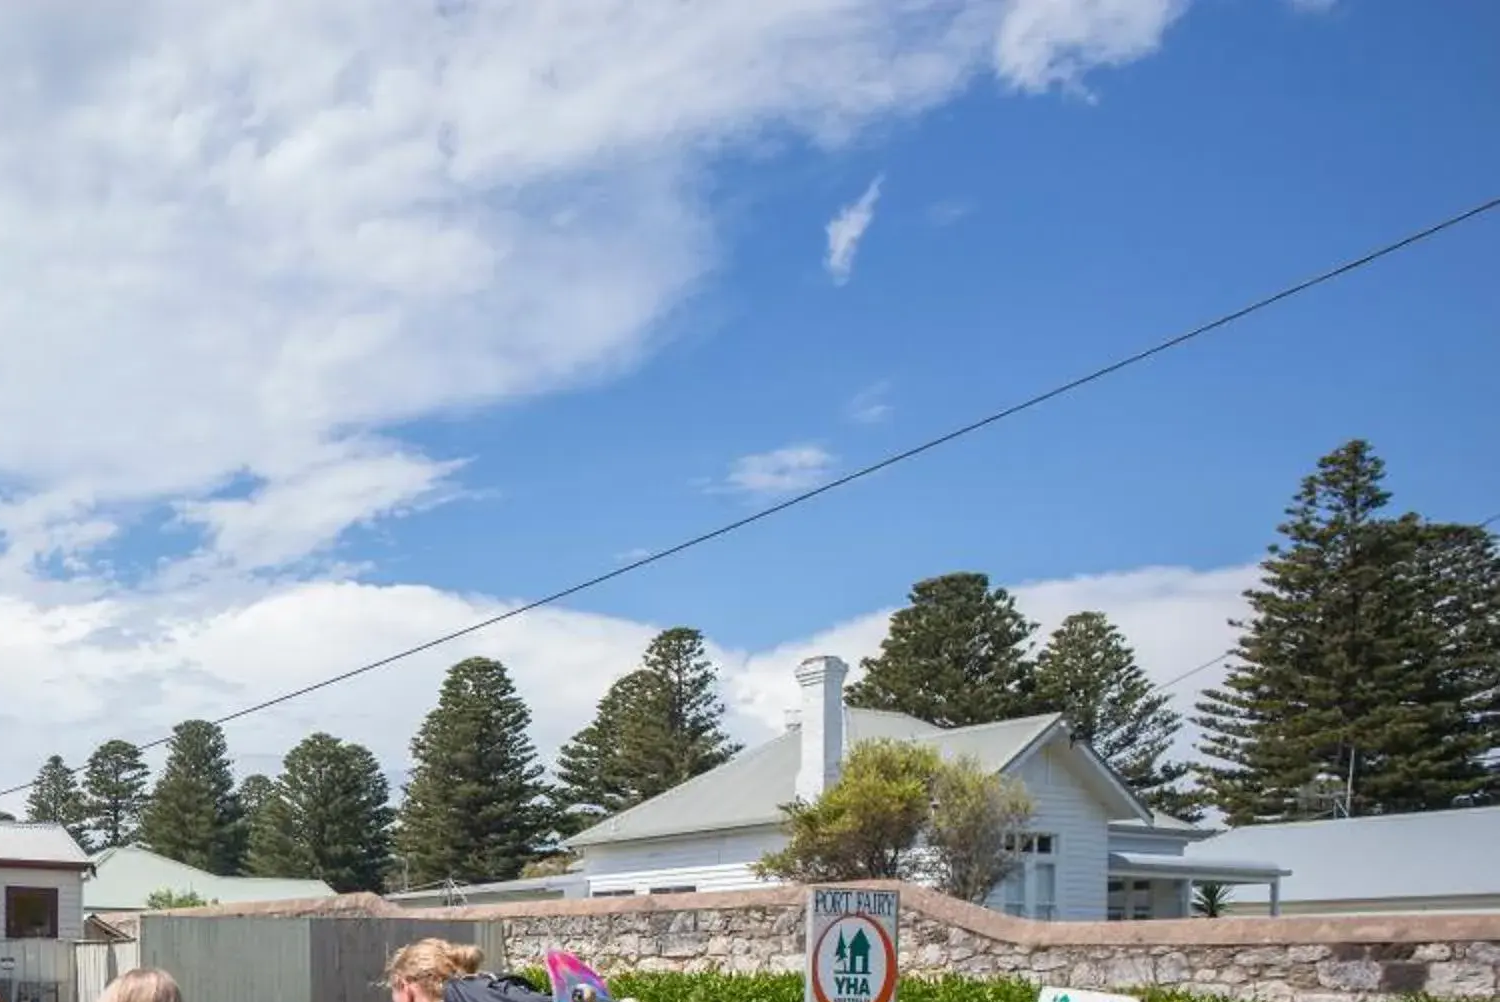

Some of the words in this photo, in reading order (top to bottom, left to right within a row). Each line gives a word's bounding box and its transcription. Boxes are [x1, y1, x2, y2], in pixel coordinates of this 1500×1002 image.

[814, 889, 852, 914] PORT
[855, 892, 896, 917] FAIRY
[834, 976, 871, 996] YHA
